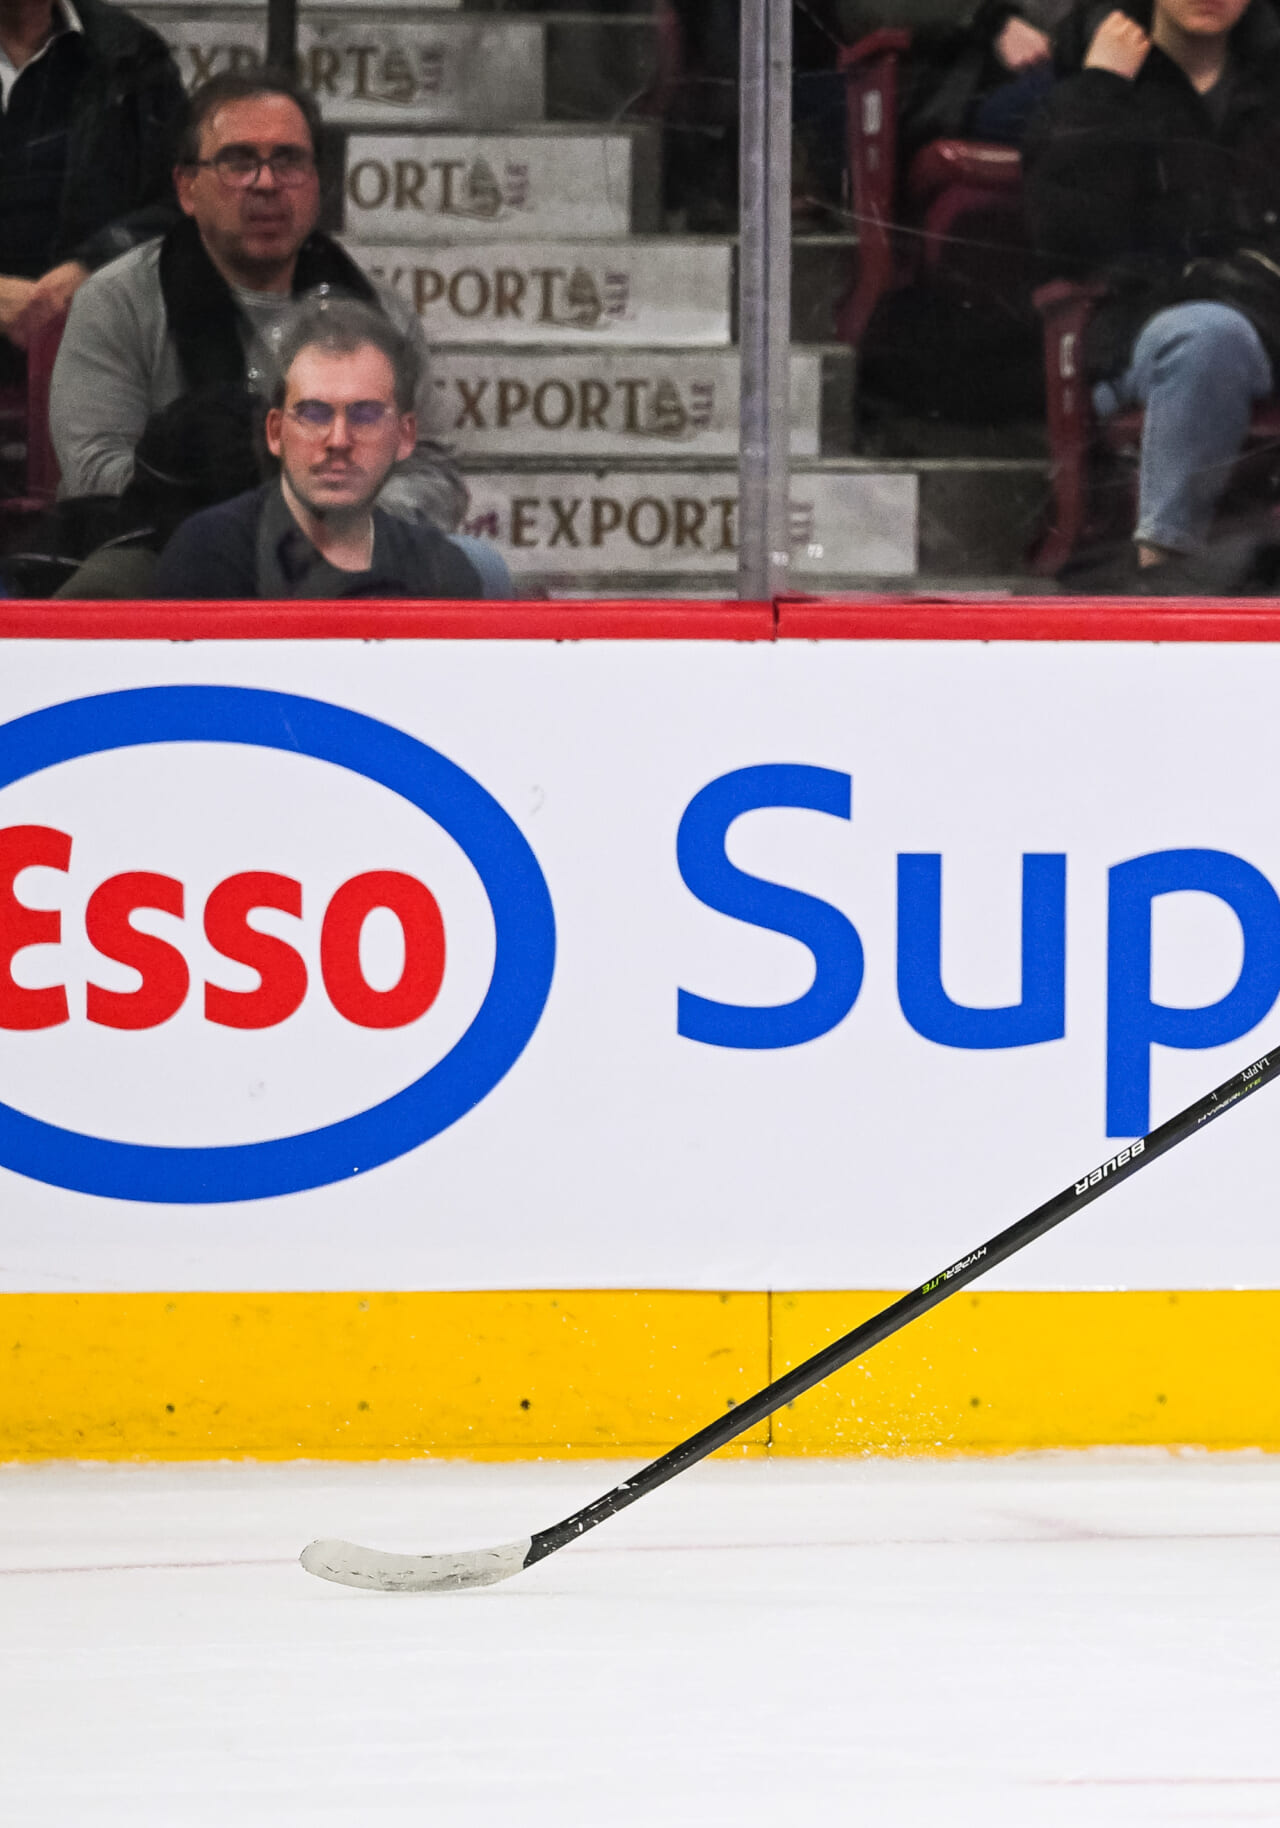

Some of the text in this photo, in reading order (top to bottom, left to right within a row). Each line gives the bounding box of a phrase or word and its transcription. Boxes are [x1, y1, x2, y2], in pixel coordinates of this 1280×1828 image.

[434, 377, 650, 432] XPORT
[510, 496, 739, 553] EXPORT
[0, 825, 446, 1031] Esso
[1241, 1057, 1270, 1082] LAFFY
[1074, 1138, 1145, 1196] BAUER
[921, 1246, 987, 1295] HYPERLITE
